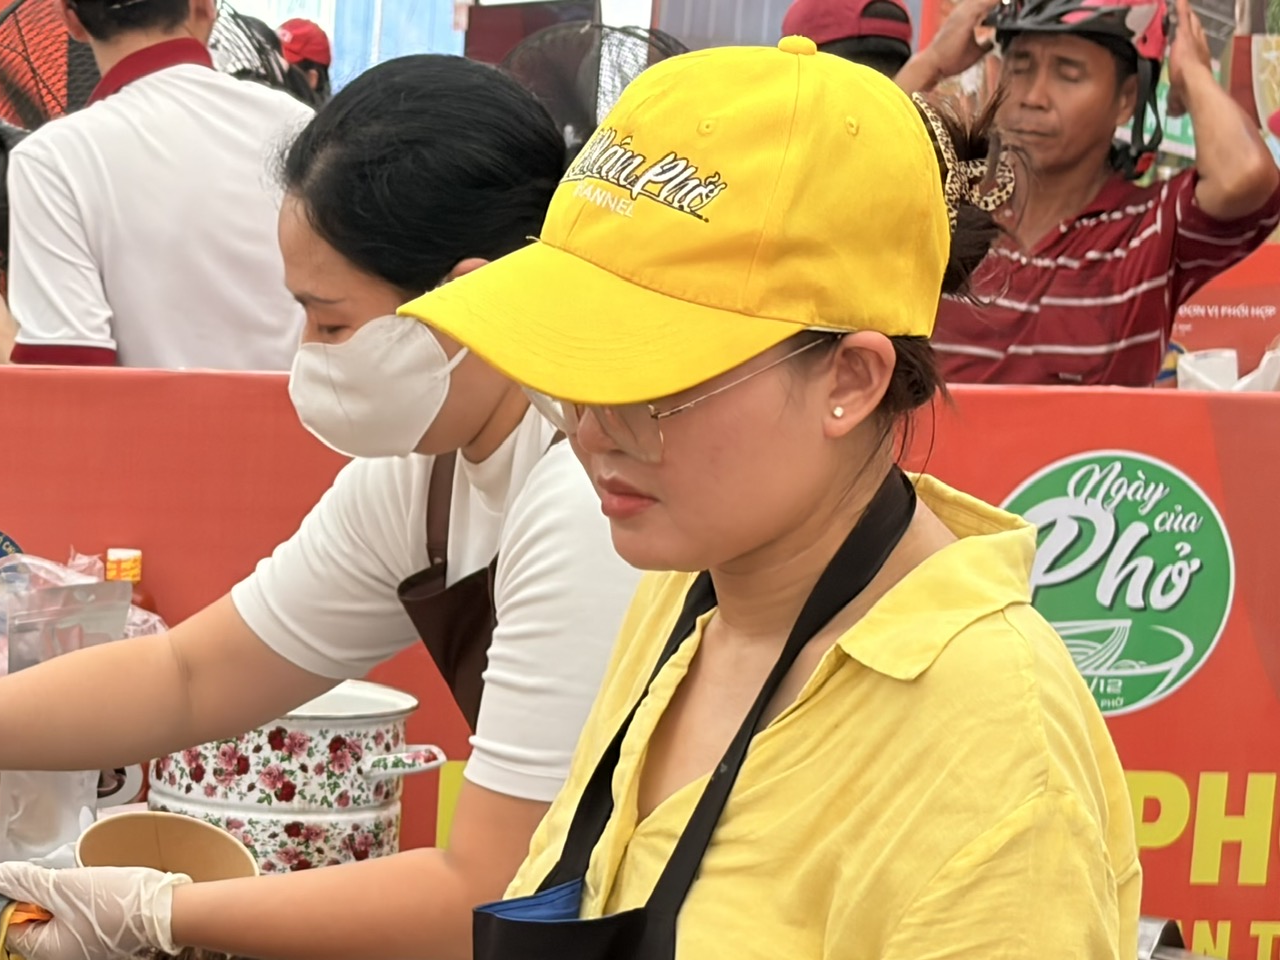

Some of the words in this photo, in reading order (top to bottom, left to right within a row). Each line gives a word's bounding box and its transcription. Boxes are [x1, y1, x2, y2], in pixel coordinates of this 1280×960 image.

[1067, 461, 1170, 516] Ngày
[1154, 504, 1203, 533] của
[1023, 496, 1201, 610] Phở
[1125, 770, 1280, 886] PH
